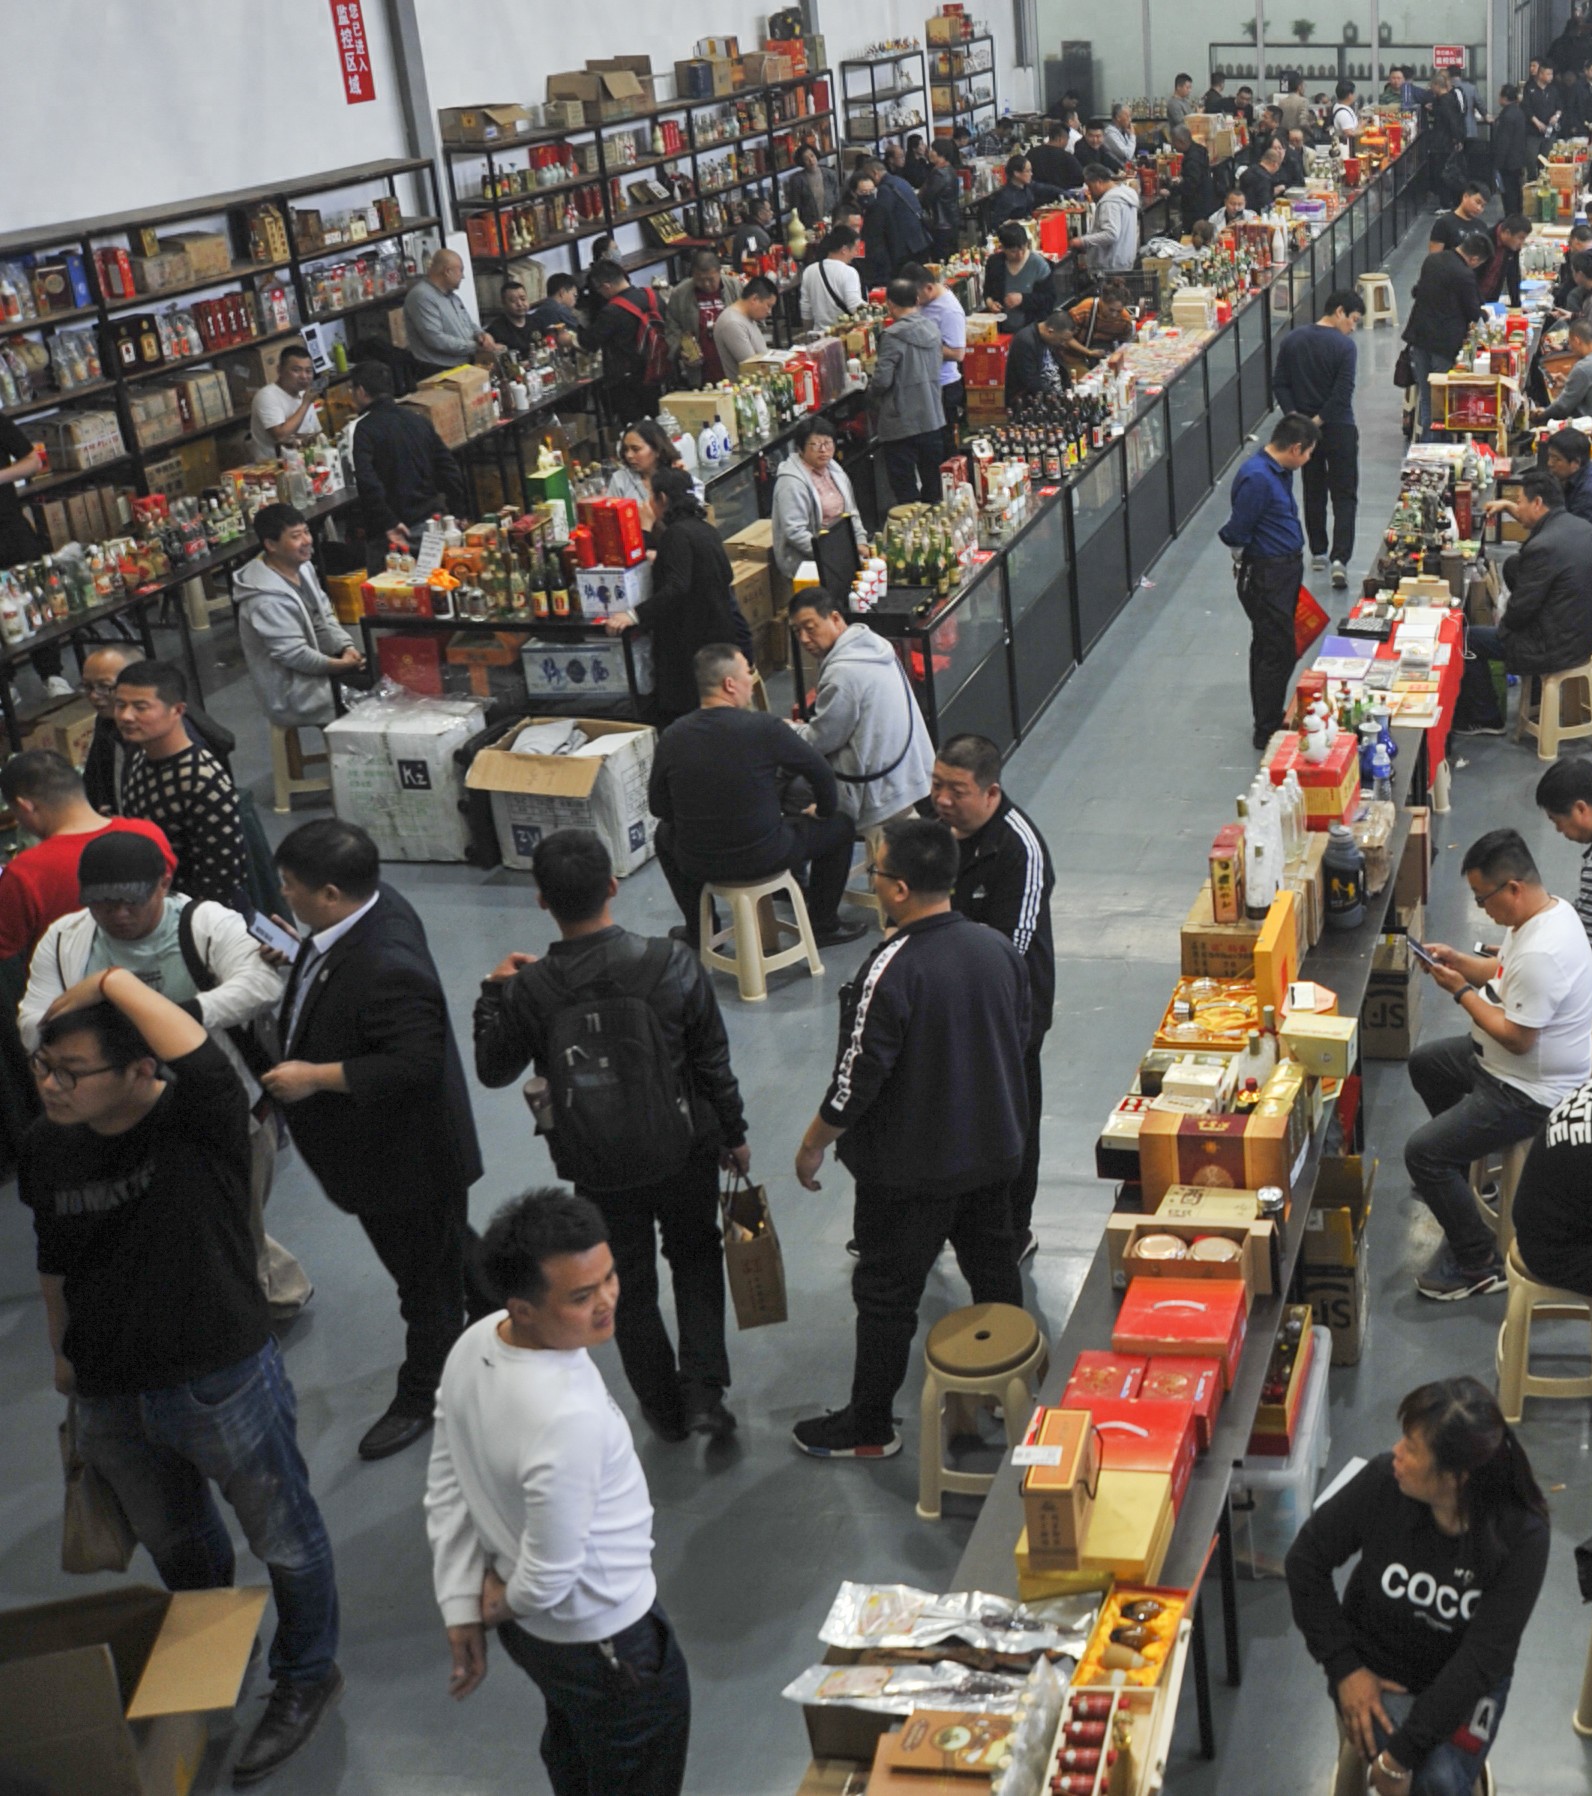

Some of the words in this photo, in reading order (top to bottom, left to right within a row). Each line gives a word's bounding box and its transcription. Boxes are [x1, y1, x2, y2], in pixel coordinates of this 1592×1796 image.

[336, 4, 362, 95] 监控区域
[348, 3, 368, 72] 您已进入
